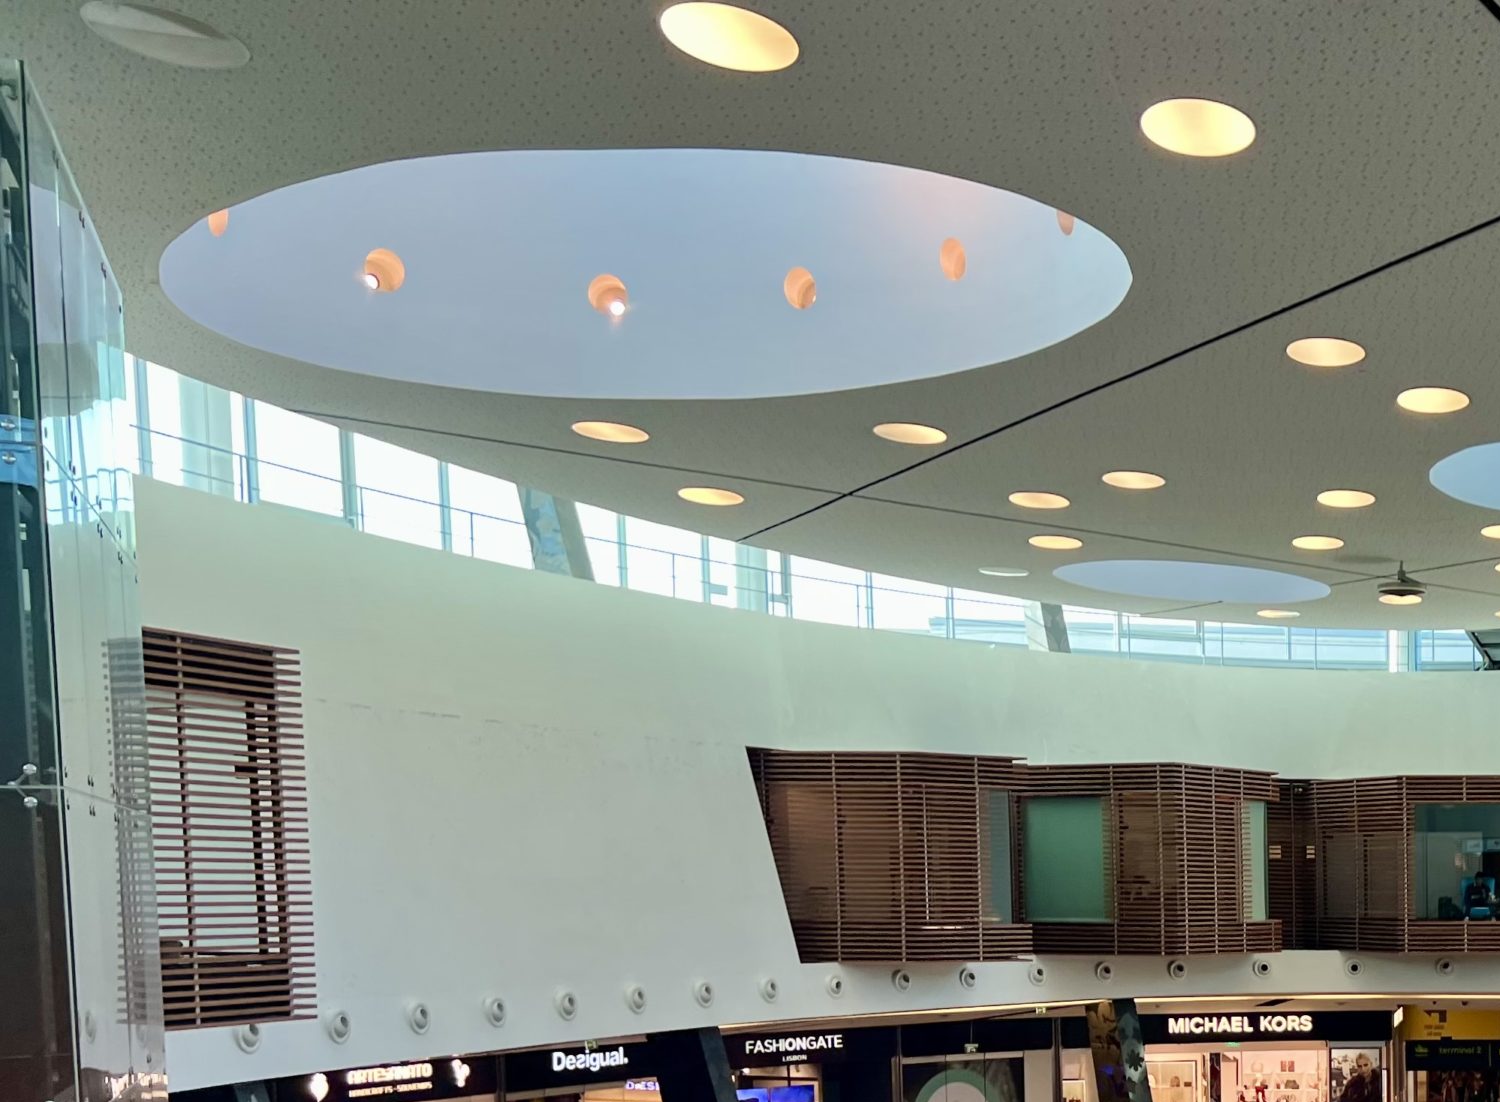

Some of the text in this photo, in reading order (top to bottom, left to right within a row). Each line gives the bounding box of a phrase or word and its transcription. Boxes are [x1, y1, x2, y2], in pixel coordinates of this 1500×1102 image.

[1168, 1015, 1313, 1034] MICHAEL KORS
[745, 1034, 843, 1054] FASHIONGATE
[782, 1054, 807, 1062] LISBON
[347, 1062, 433, 1085] ARTESANATO
